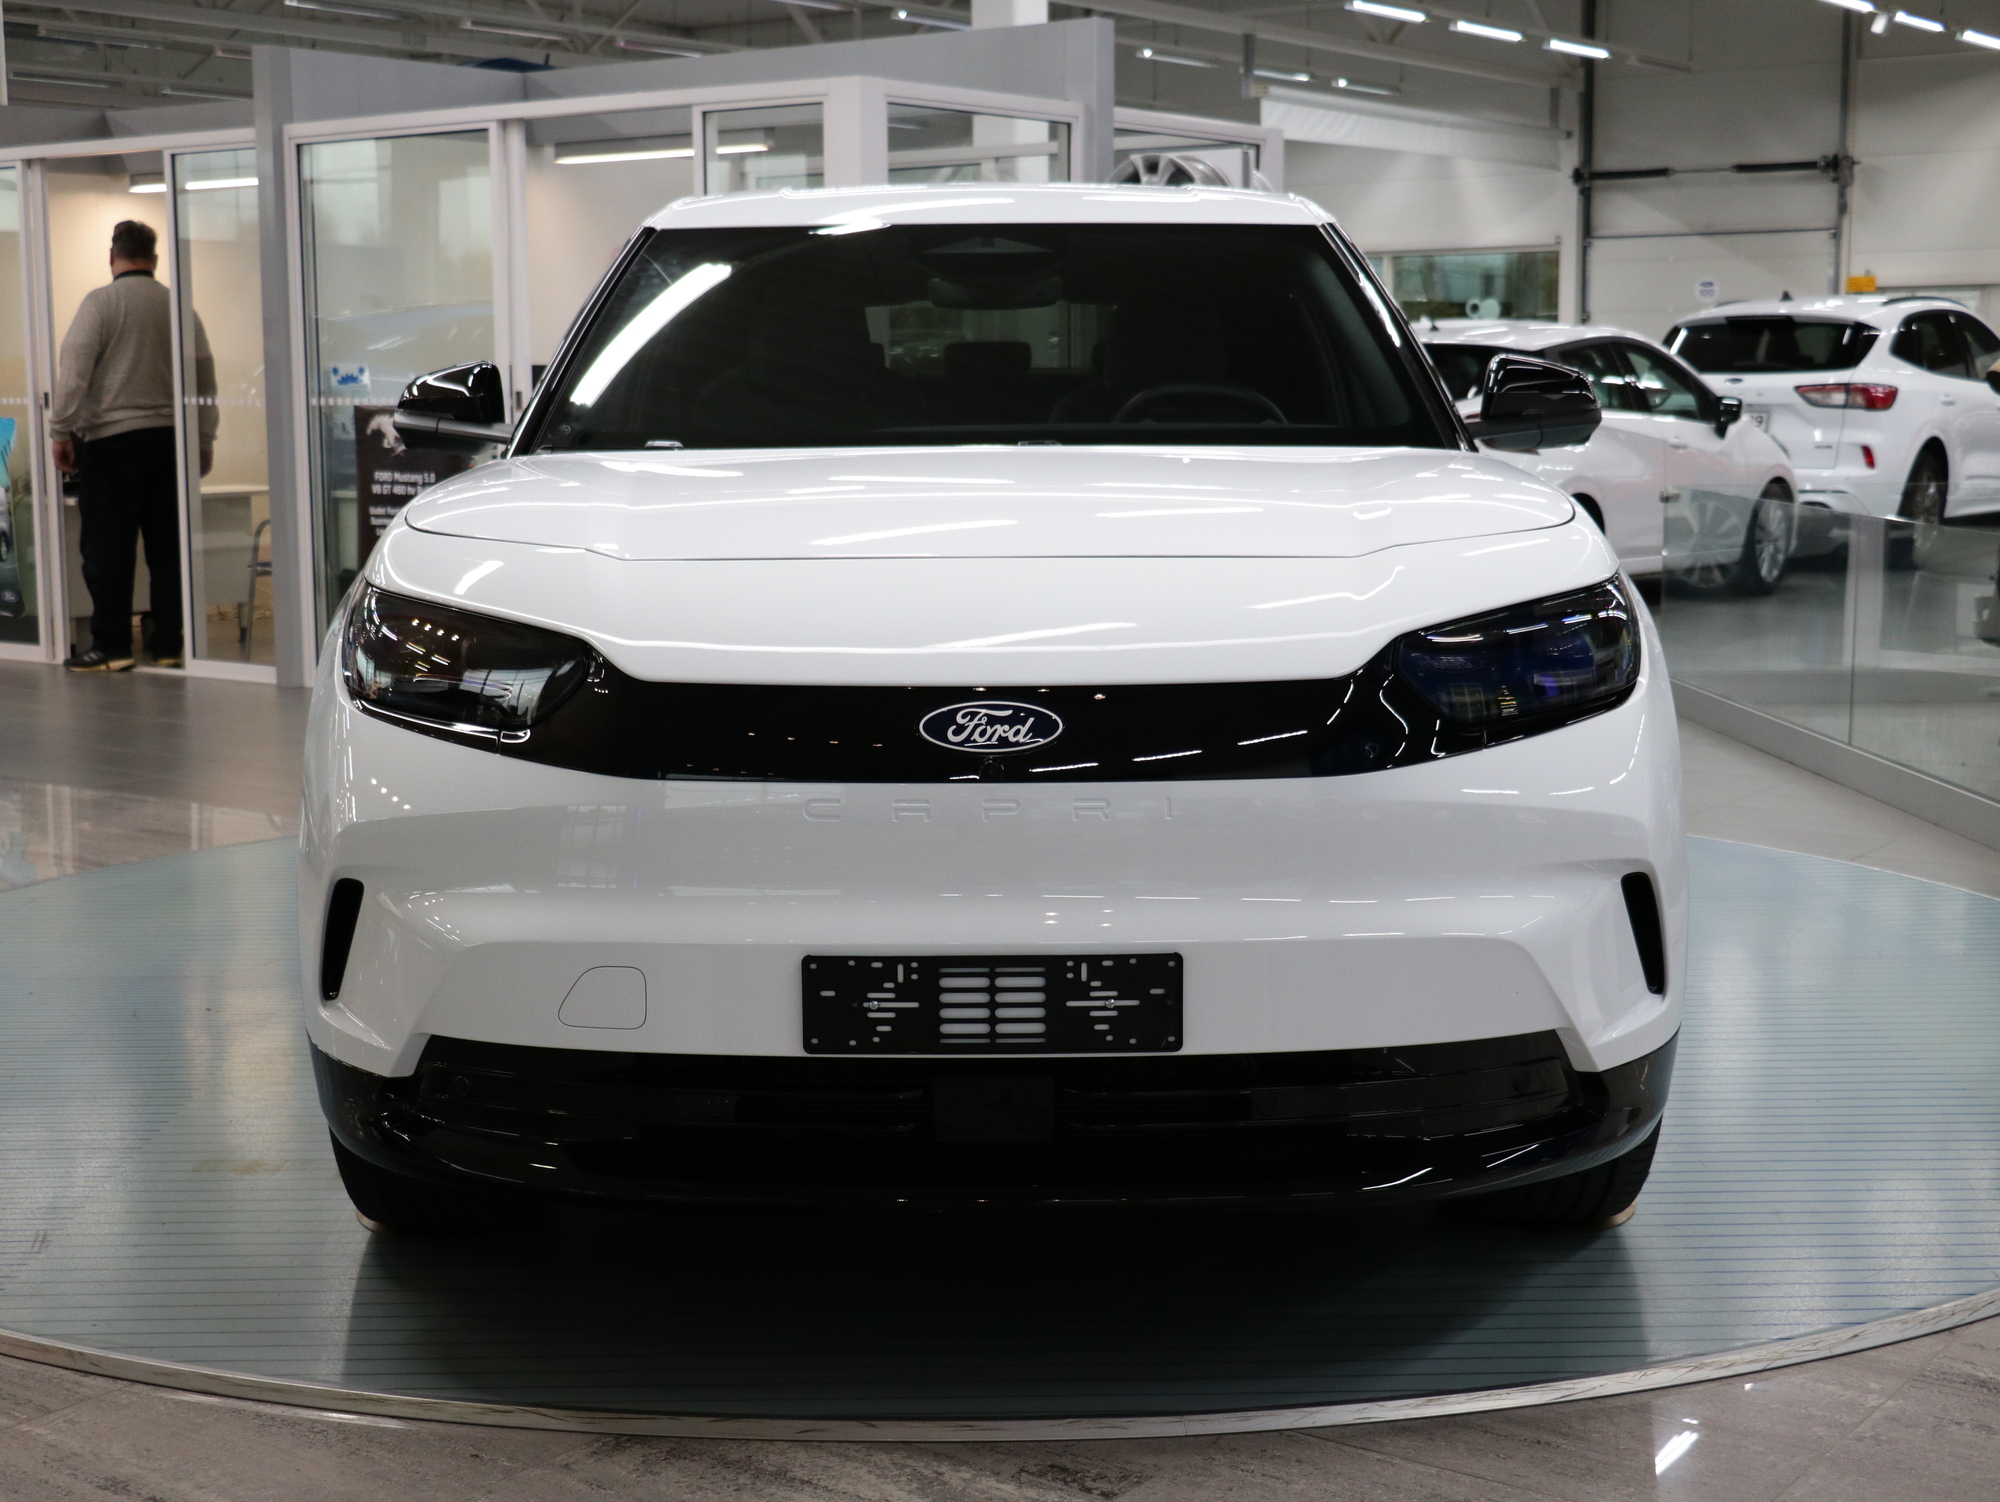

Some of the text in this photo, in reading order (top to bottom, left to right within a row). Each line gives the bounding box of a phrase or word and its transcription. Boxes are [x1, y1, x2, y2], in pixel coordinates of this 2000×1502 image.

[374, 471, 436, 485] FORD Mustang 5.0
[947, 708, 1035, 743] Ford
[802, 796, 1173, 823] CAPRI
